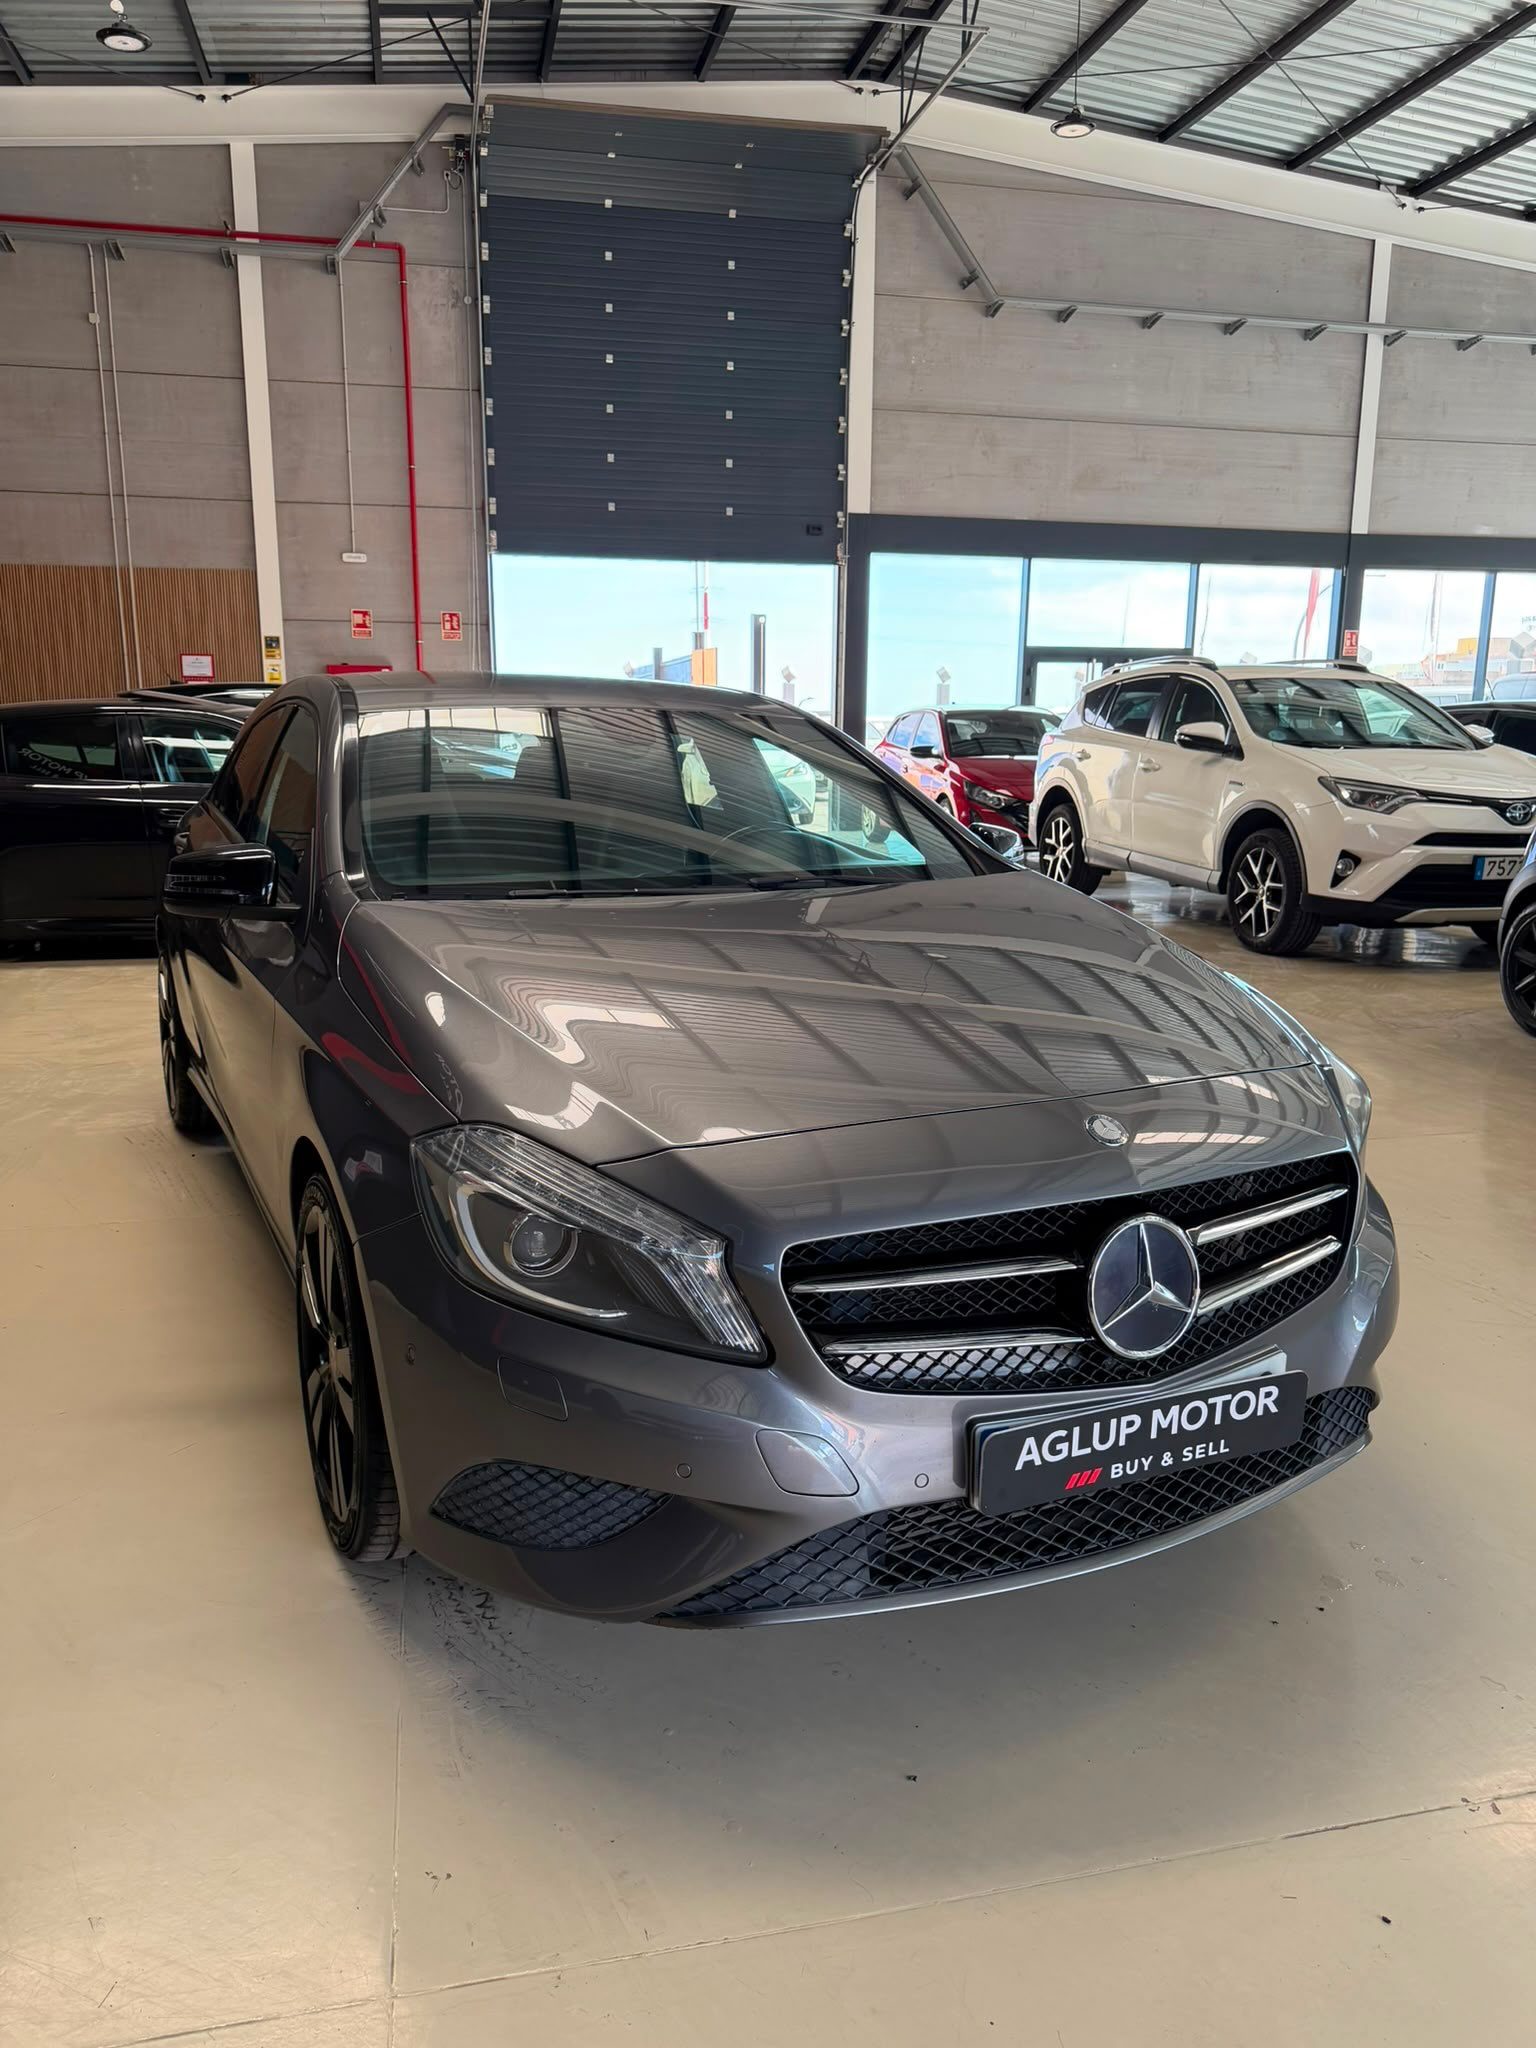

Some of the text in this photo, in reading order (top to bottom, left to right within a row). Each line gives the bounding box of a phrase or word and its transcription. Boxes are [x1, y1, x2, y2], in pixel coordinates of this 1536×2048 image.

[1014, 1385, 1279, 1471] AGLUP MOTOR
[1110, 1439, 1230, 1479] BUY & SELL
